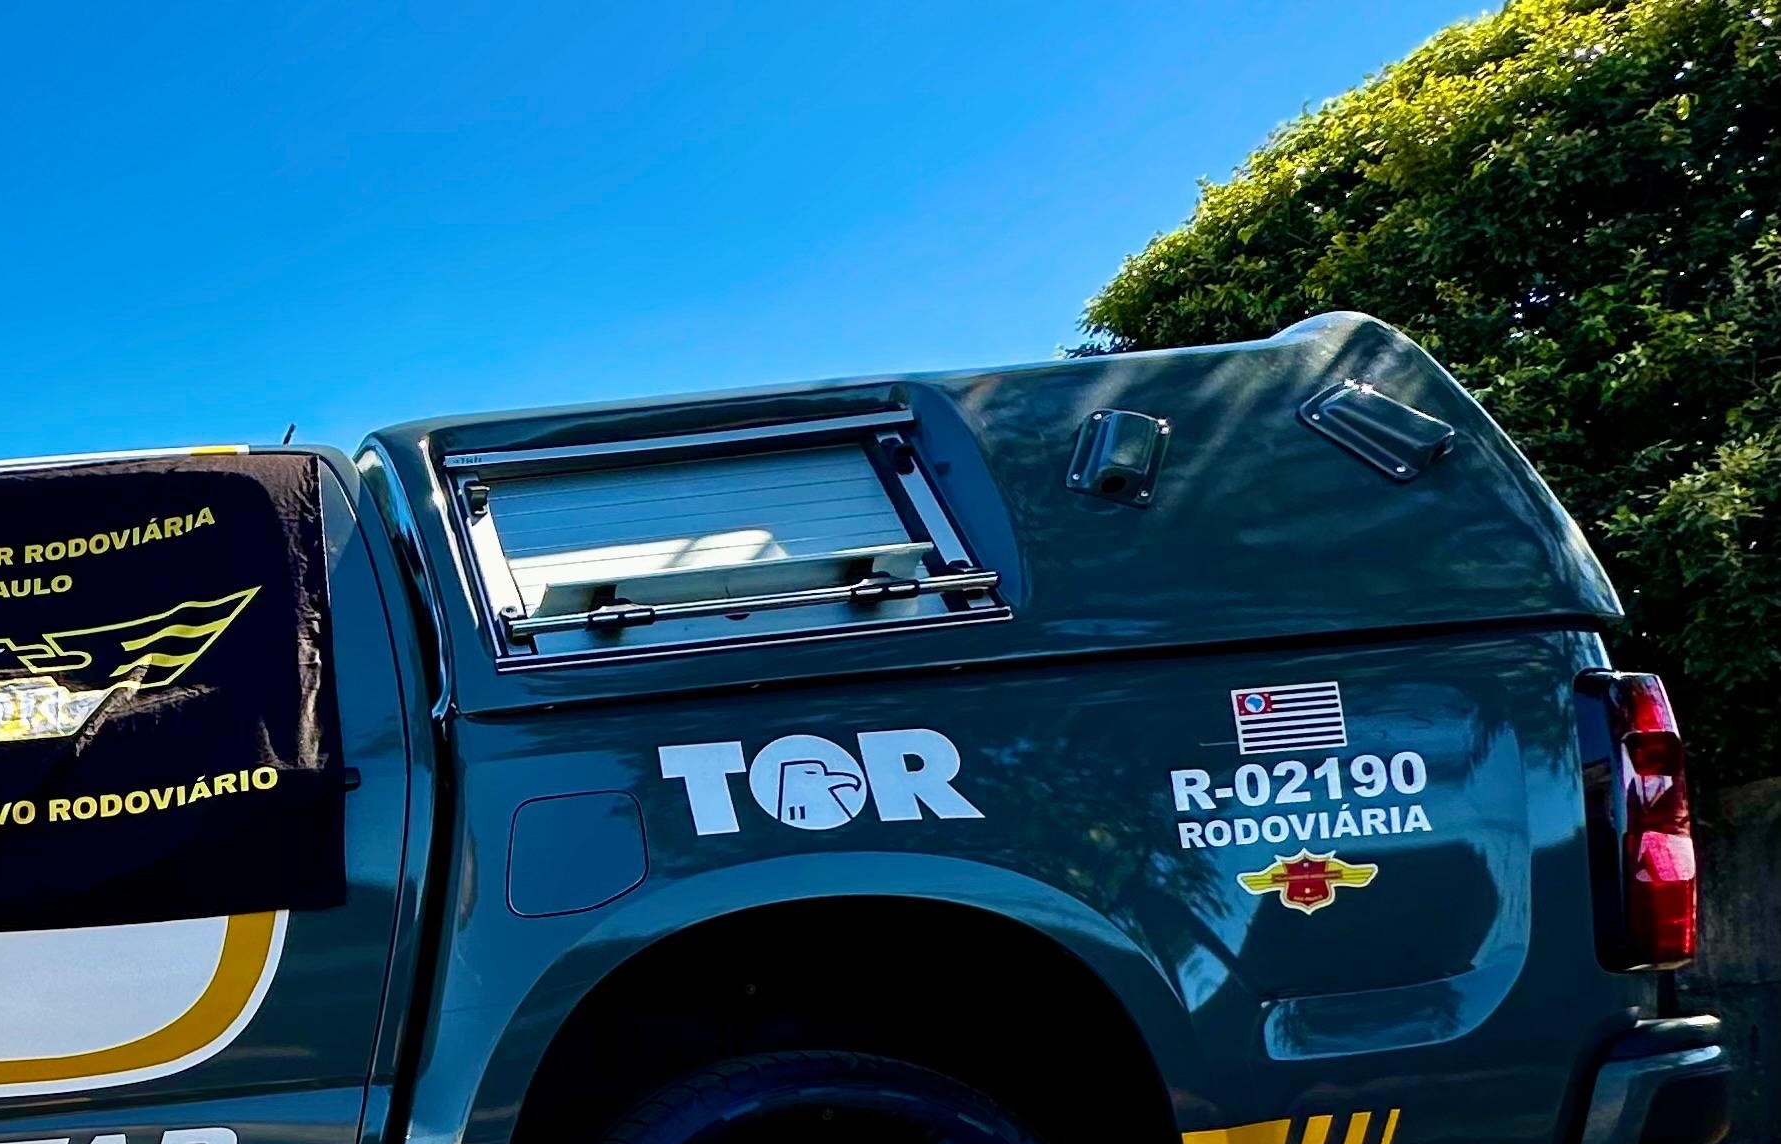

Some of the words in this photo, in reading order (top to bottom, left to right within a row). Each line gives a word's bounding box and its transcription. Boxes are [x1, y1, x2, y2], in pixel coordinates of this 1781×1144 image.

[23, 506, 216, 564] RODOVIÁRIA
[48, 765, 279, 823] RODOVIÁRIO
[657, 727, 986, 836] TOR
[1170, 750, 1428, 812] R-02190
[1177, 803, 1433, 849] RODOVIÁRIA
